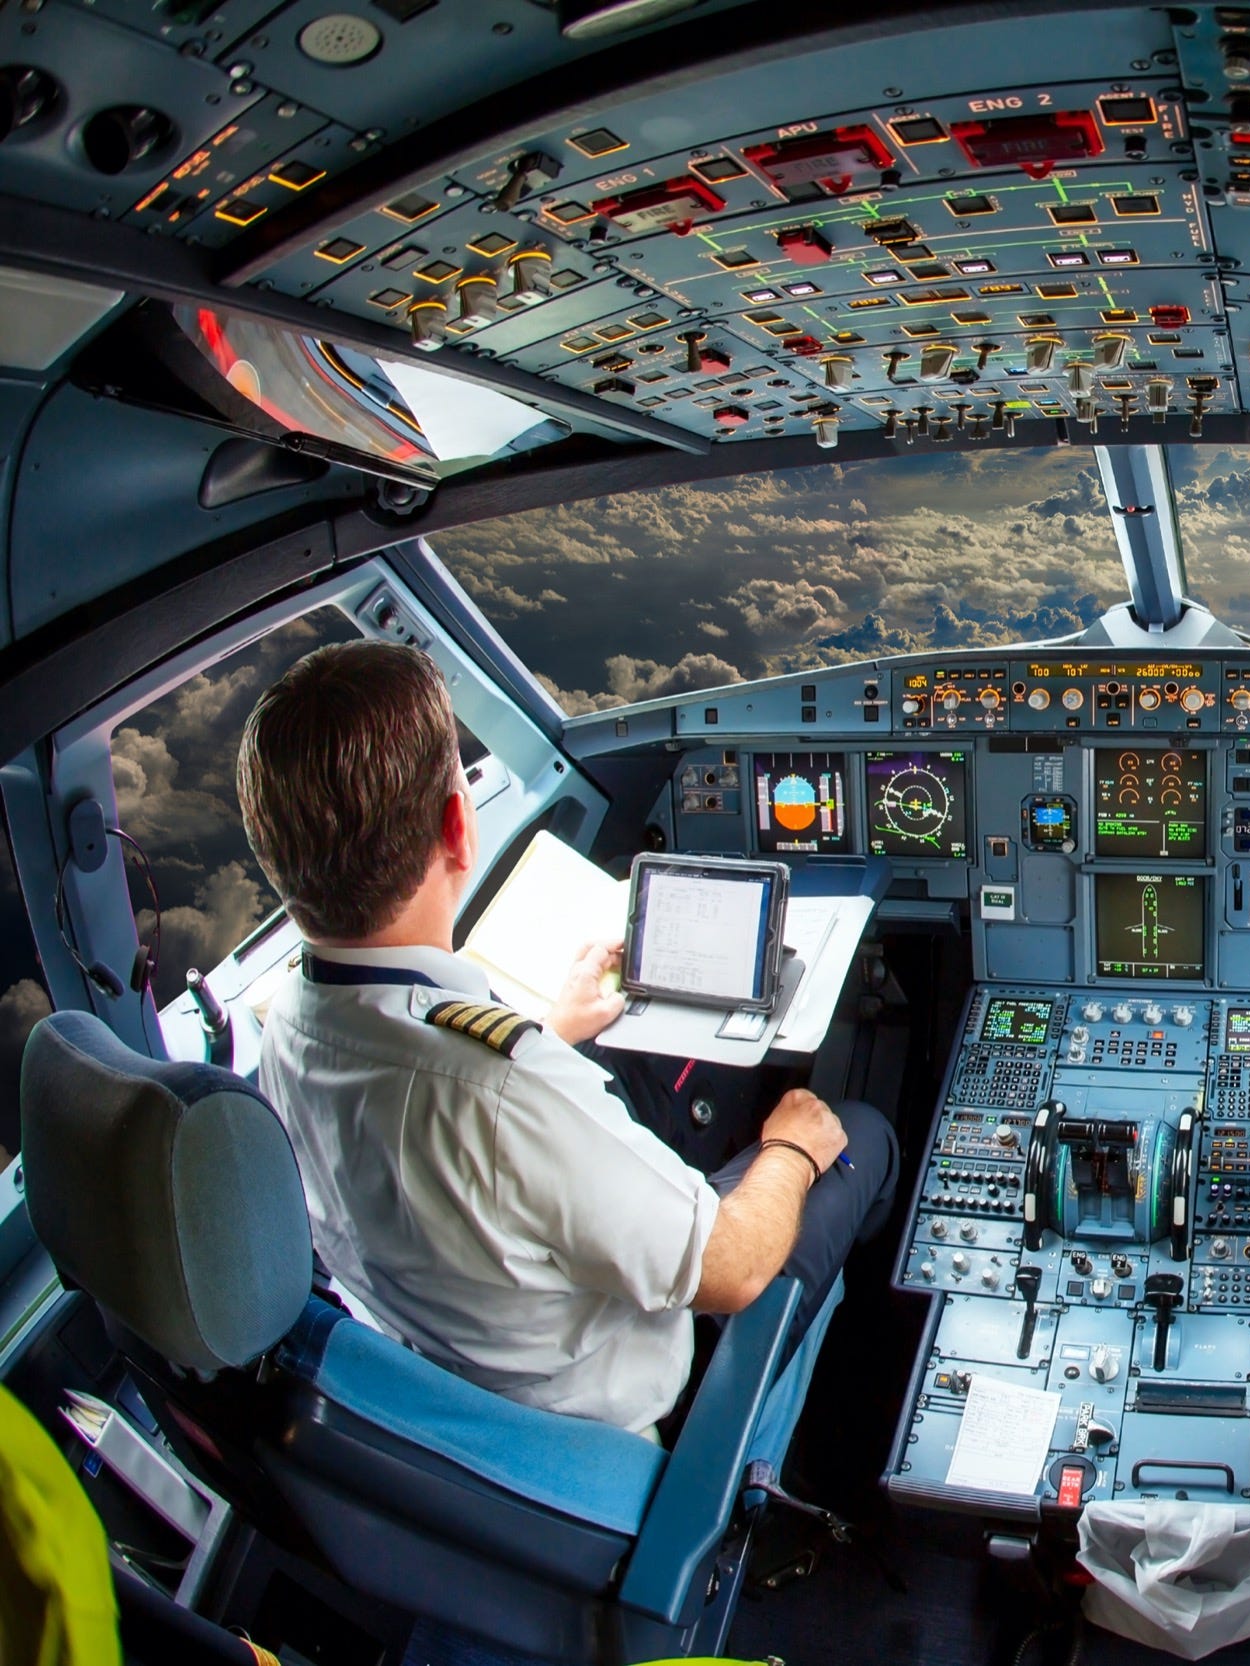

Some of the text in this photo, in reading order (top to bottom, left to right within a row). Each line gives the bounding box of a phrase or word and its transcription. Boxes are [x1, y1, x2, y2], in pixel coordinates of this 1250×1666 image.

[968, 93, 1052, 113] ENG 2
[776, 121, 819, 139] APU
[1158, 104, 1175, 139] FIRE
[1121, 127, 1144, 135] TEST
[793, 155, 840, 172] FIRE
[595, 167, 656, 192] ENG 1
[636, 203, 676, 221] FIRE
[1033, 668, 1050, 677] 100
[1066, 668, 1083, 677] 107
[1136, 668, 1165, 677] 26000
[908, 679, 928, 688] 1004
[1072, 1251, 1086, 1259] ENG
[1079, 1404, 1091, 1426] PARK
[1076, 1428, 1087, 1448] BRK
